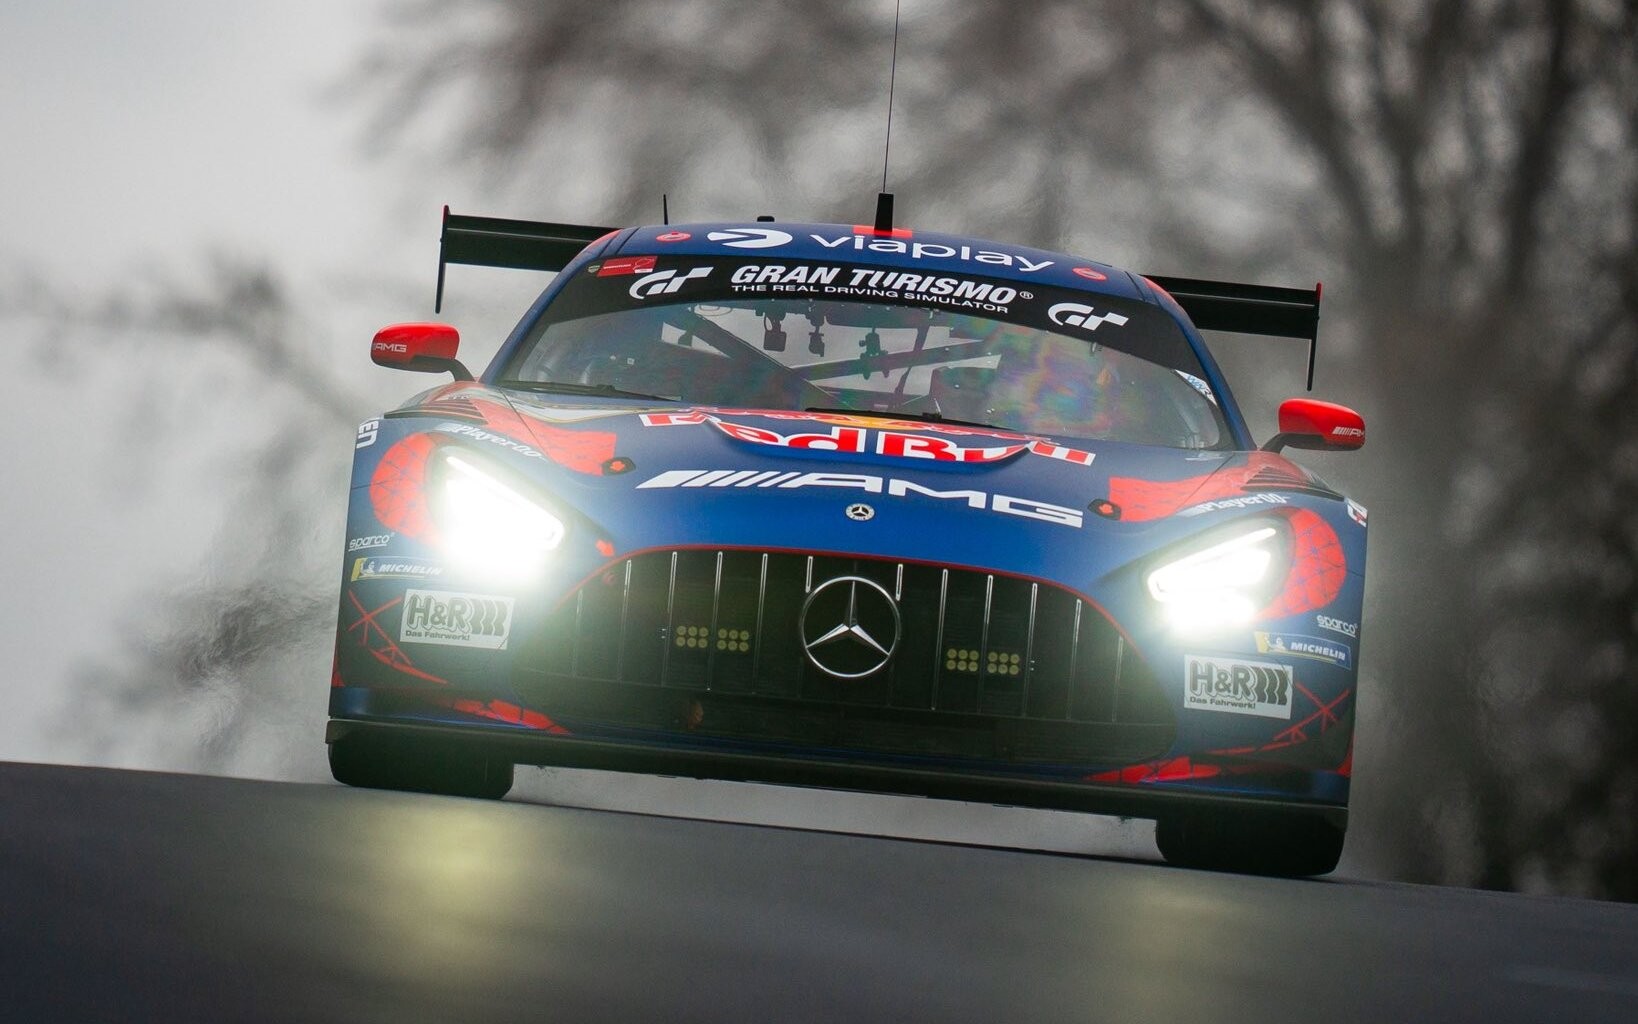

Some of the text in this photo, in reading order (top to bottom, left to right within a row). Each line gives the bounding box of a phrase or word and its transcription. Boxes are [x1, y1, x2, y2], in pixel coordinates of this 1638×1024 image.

[810, 234, 1055, 272] viaplay
[731, 265, 841, 284] GRAN
[773, 285, 819, 293] REAL
[825, 286, 898, 298] DRIVING
[904, 293, 1008, 314] SIMULATOR
[373, 342, 407, 353] AMG
[778, 472, 1084, 528] AMG
[379, 563, 443, 576] MICHELIN
[405, 593, 472, 632] H&R
[405, 630, 470, 641] Das Fahrwerk!
[1290, 642, 1346, 661] MICHELIN
[1189, 660, 1254, 699] H&R
[1210, 698, 1256, 709] Fahrwerk!
